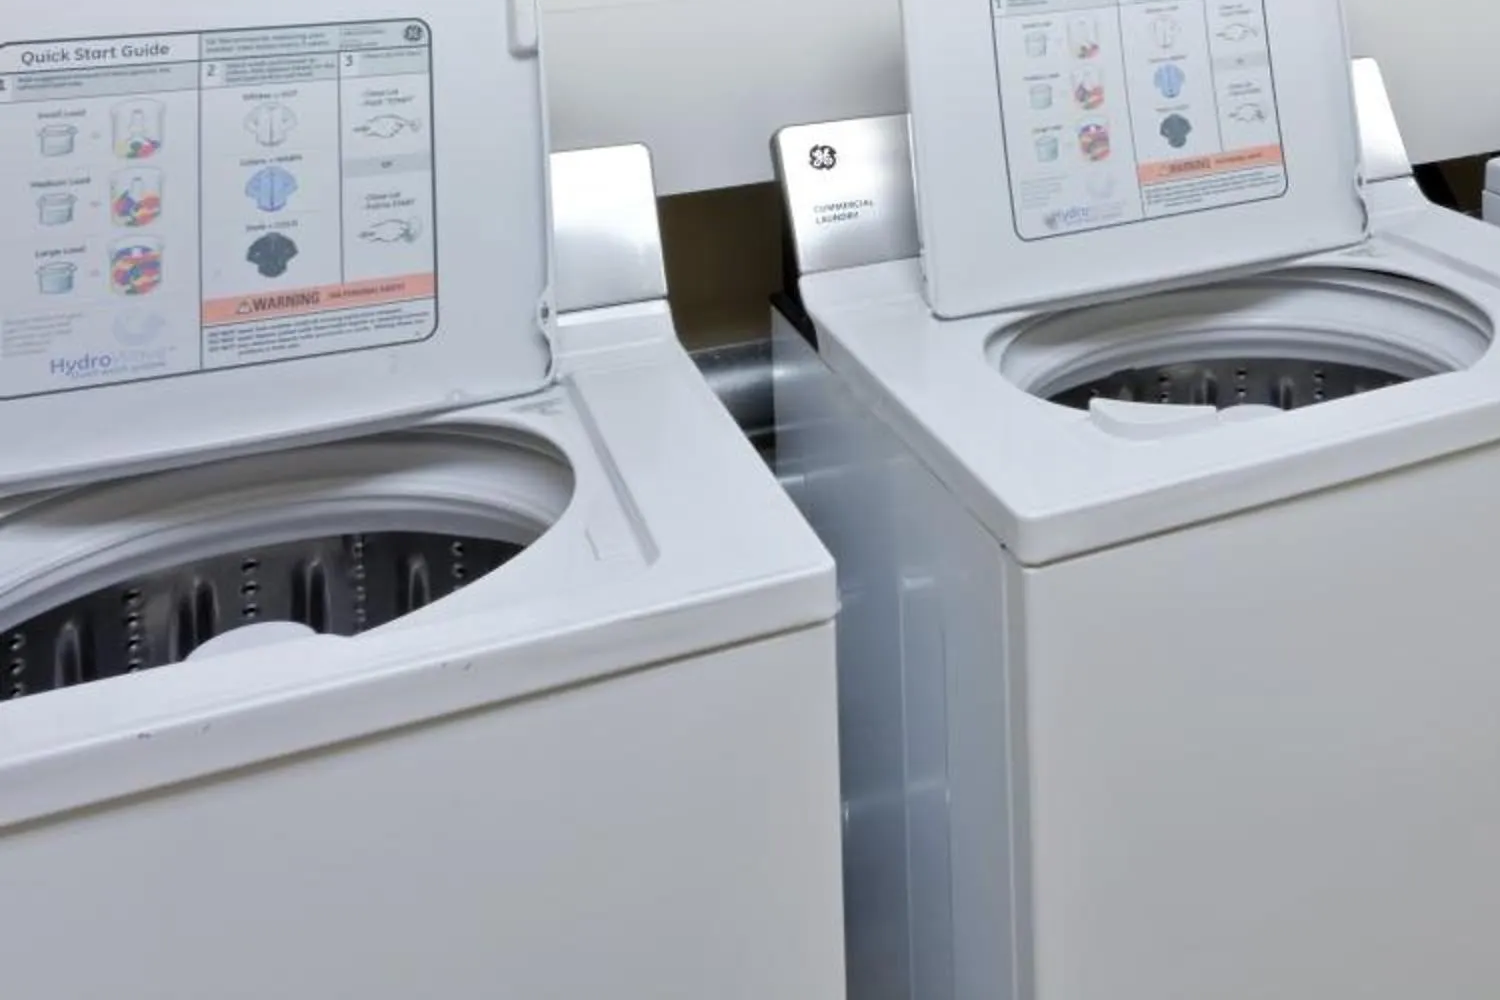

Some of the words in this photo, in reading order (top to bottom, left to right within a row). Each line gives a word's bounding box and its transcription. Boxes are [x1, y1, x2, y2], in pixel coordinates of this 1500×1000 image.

[21, 48, 70, 66] Quick
[74, 46, 117, 61] Start
[121, 42, 170, 58] Guide
[252, 290, 321, 313] WARNING
